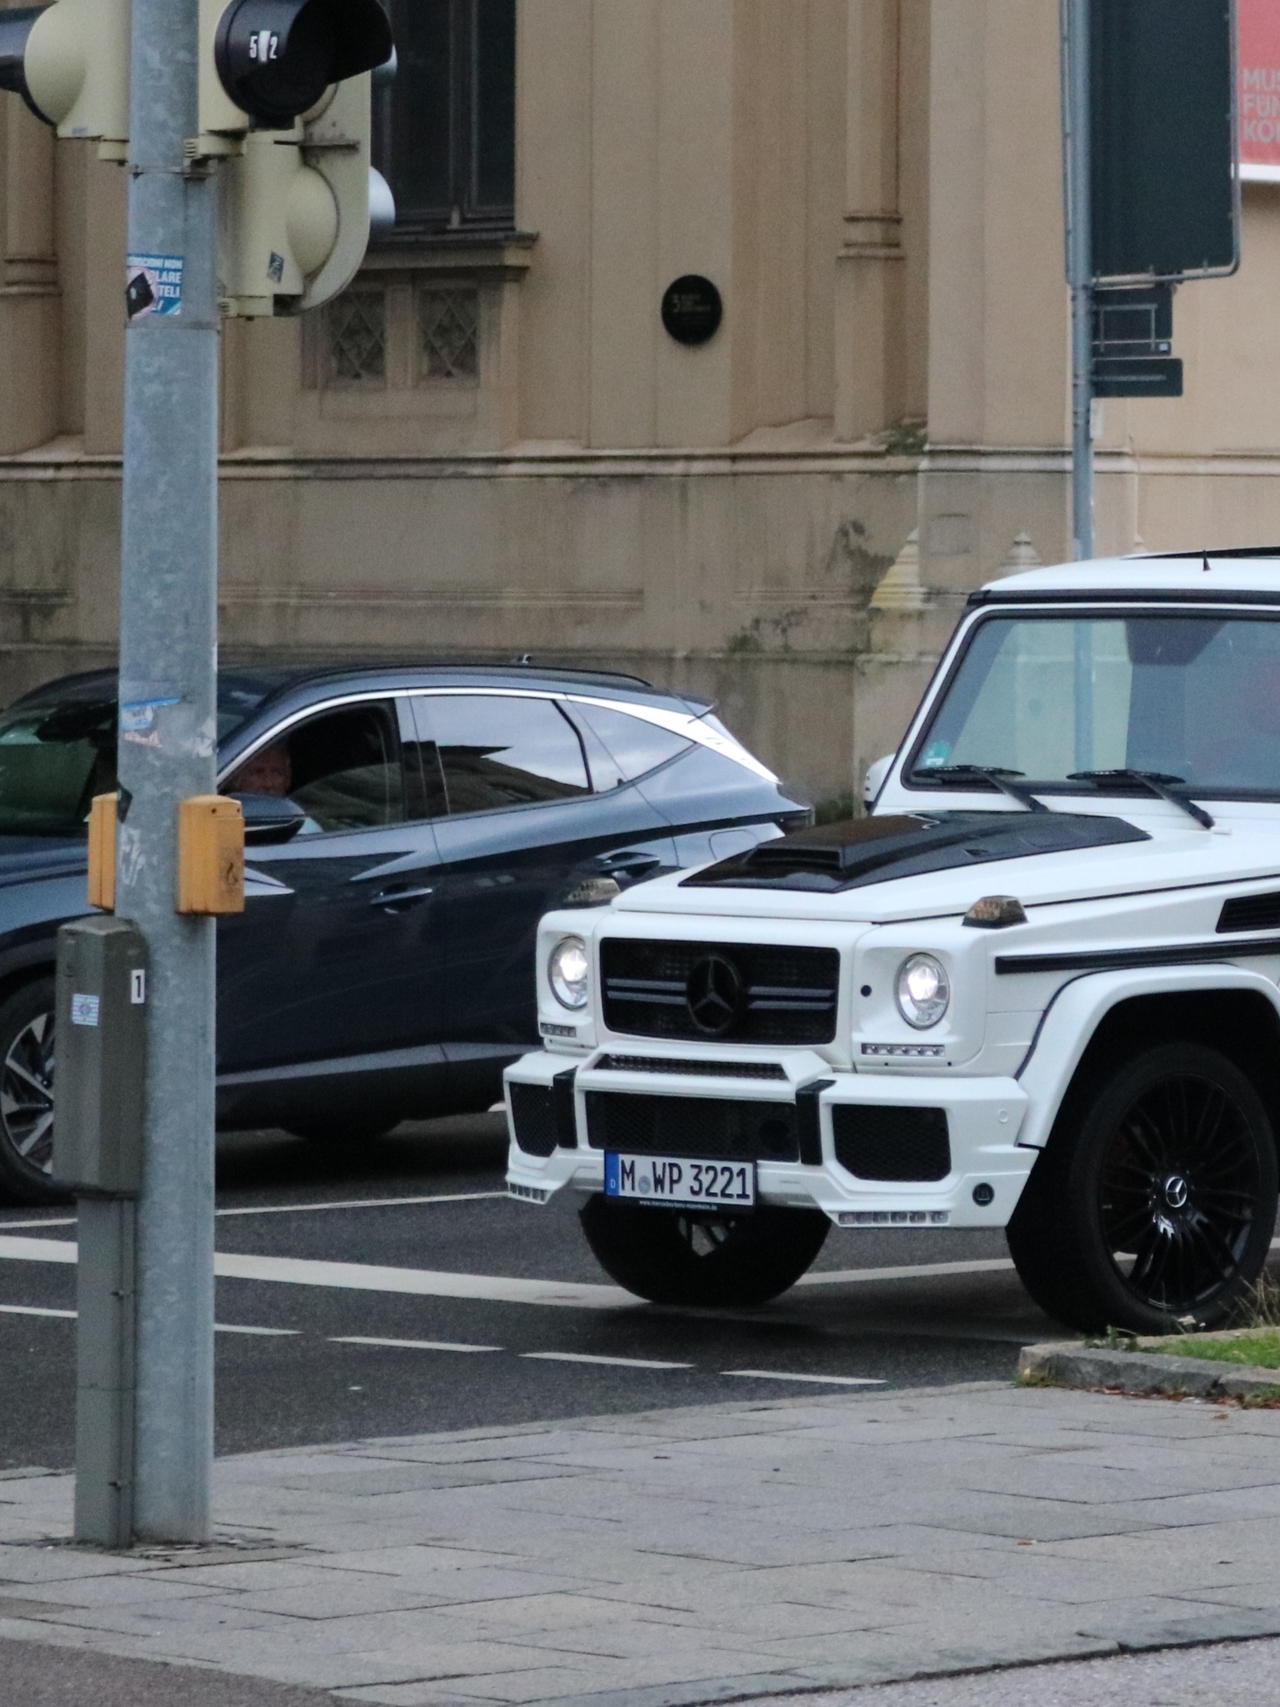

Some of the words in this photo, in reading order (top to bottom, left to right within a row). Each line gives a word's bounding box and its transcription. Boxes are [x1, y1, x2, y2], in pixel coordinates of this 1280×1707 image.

[136, 975, 141, 998] 1
[620, 1159, 635, 1192] M
[652, 1161, 682, 1194] WP
[690, 1164, 750, 1199] 3221
